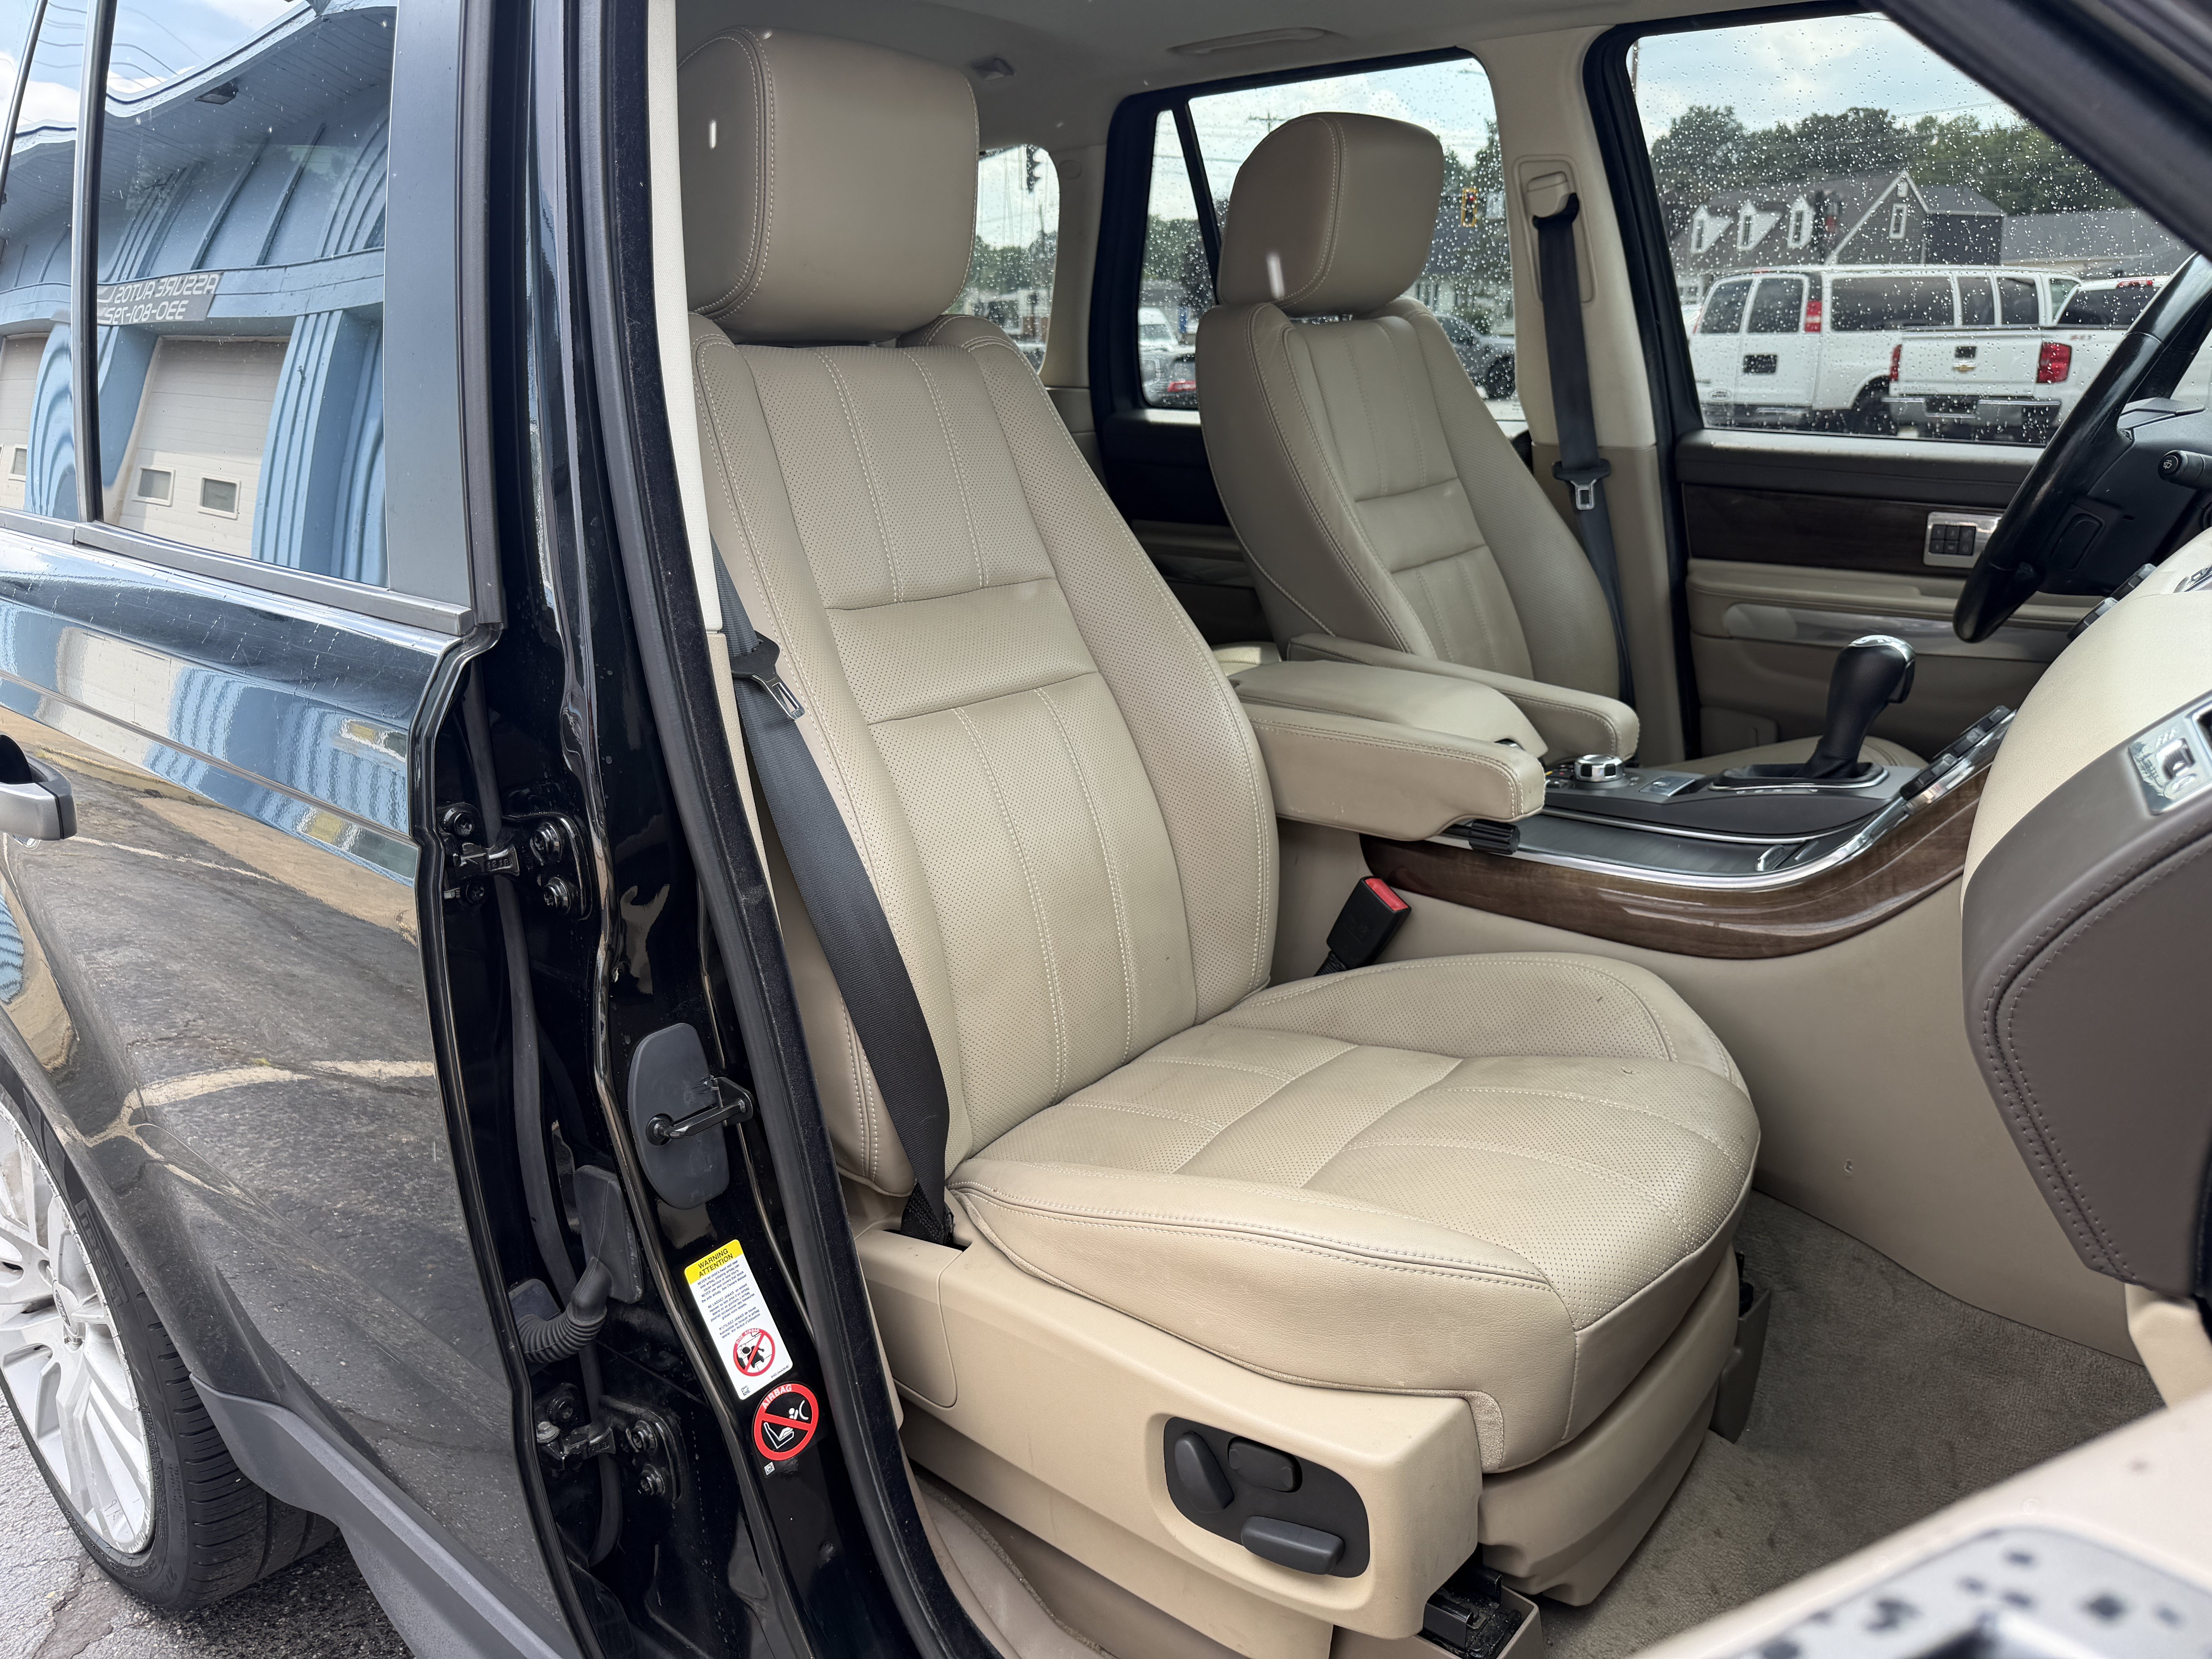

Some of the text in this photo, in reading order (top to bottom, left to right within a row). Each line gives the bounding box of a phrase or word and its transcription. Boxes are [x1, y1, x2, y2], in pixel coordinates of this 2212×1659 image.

[698, 1249, 728, 1269] WARNING
[700, 1254, 733, 1277] ATTENTION
[762, 1384, 792, 1409] AIRBAG
